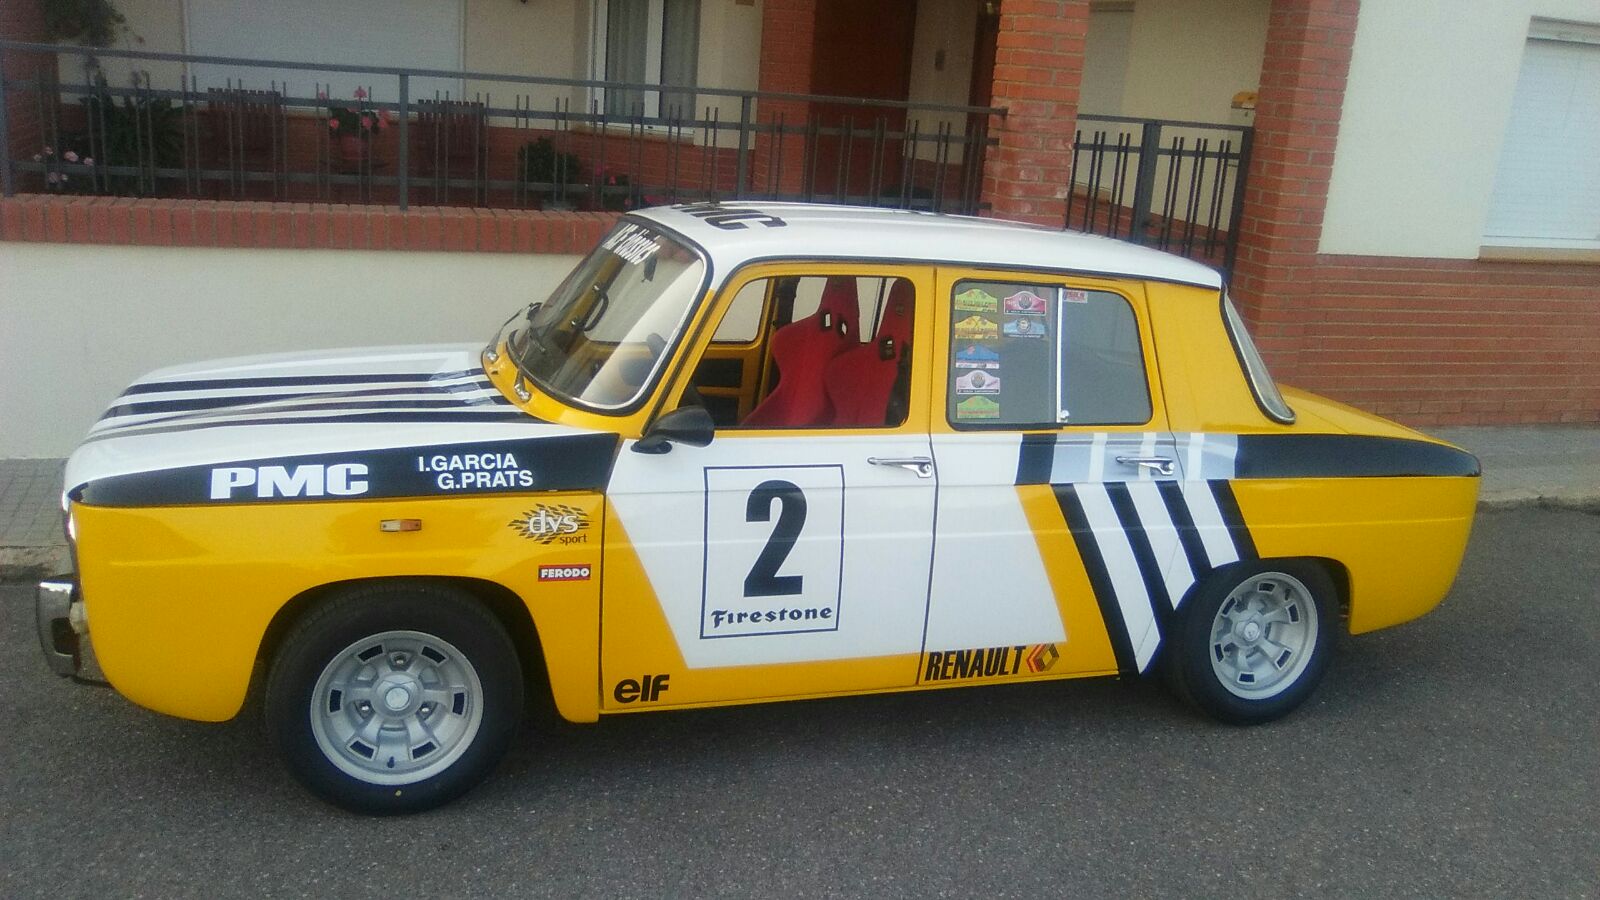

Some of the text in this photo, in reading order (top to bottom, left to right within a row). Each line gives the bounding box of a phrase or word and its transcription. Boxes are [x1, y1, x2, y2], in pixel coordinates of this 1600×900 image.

[418, 453, 518, 472] I.GARCIA
[210, 463, 369, 500] PMC
[437, 469, 534, 490] G.PRATS
[529, 510, 579, 534] dvs
[559, 534, 587, 545] sport
[743, 479, 807, 598] 2
[540, 567, 590, 578] FERODO
[711, 607, 833, 628] Firestone
[925, 645, 1026, 681] RENAULT
[614, 674, 669, 703] elf
